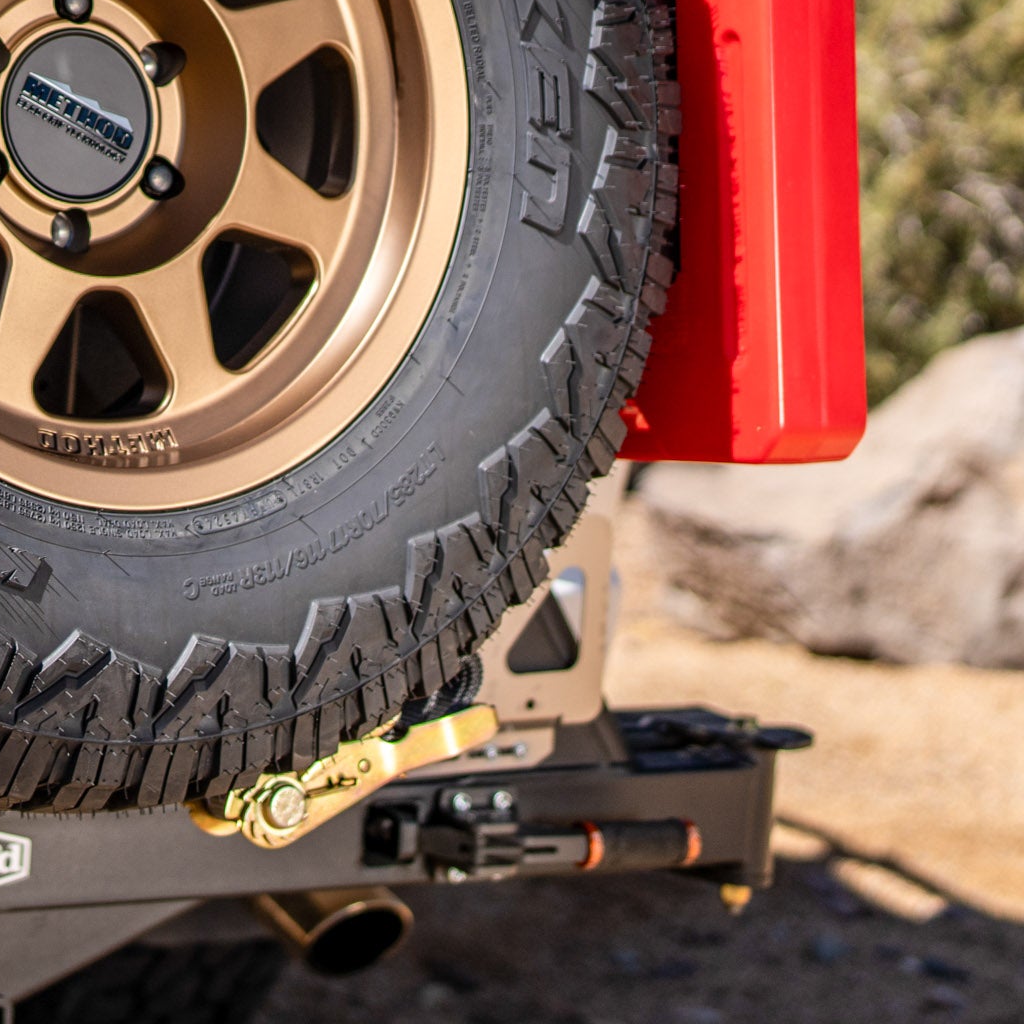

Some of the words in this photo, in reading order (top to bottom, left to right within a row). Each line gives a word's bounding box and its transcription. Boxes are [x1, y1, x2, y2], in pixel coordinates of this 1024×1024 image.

[22, 74, 134, 151] METHOD
[37, 427, 179, 457] METHOD
[330, 443, 357, 472] DOT
[322, 437, 448, 556] LT285/70R17
[235, 534, 329, 593] 116/113R
[180, 575, 203, 603] C
[197, 569, 236, 589] RANGE
[208, 579, 239, 598] LOAD
